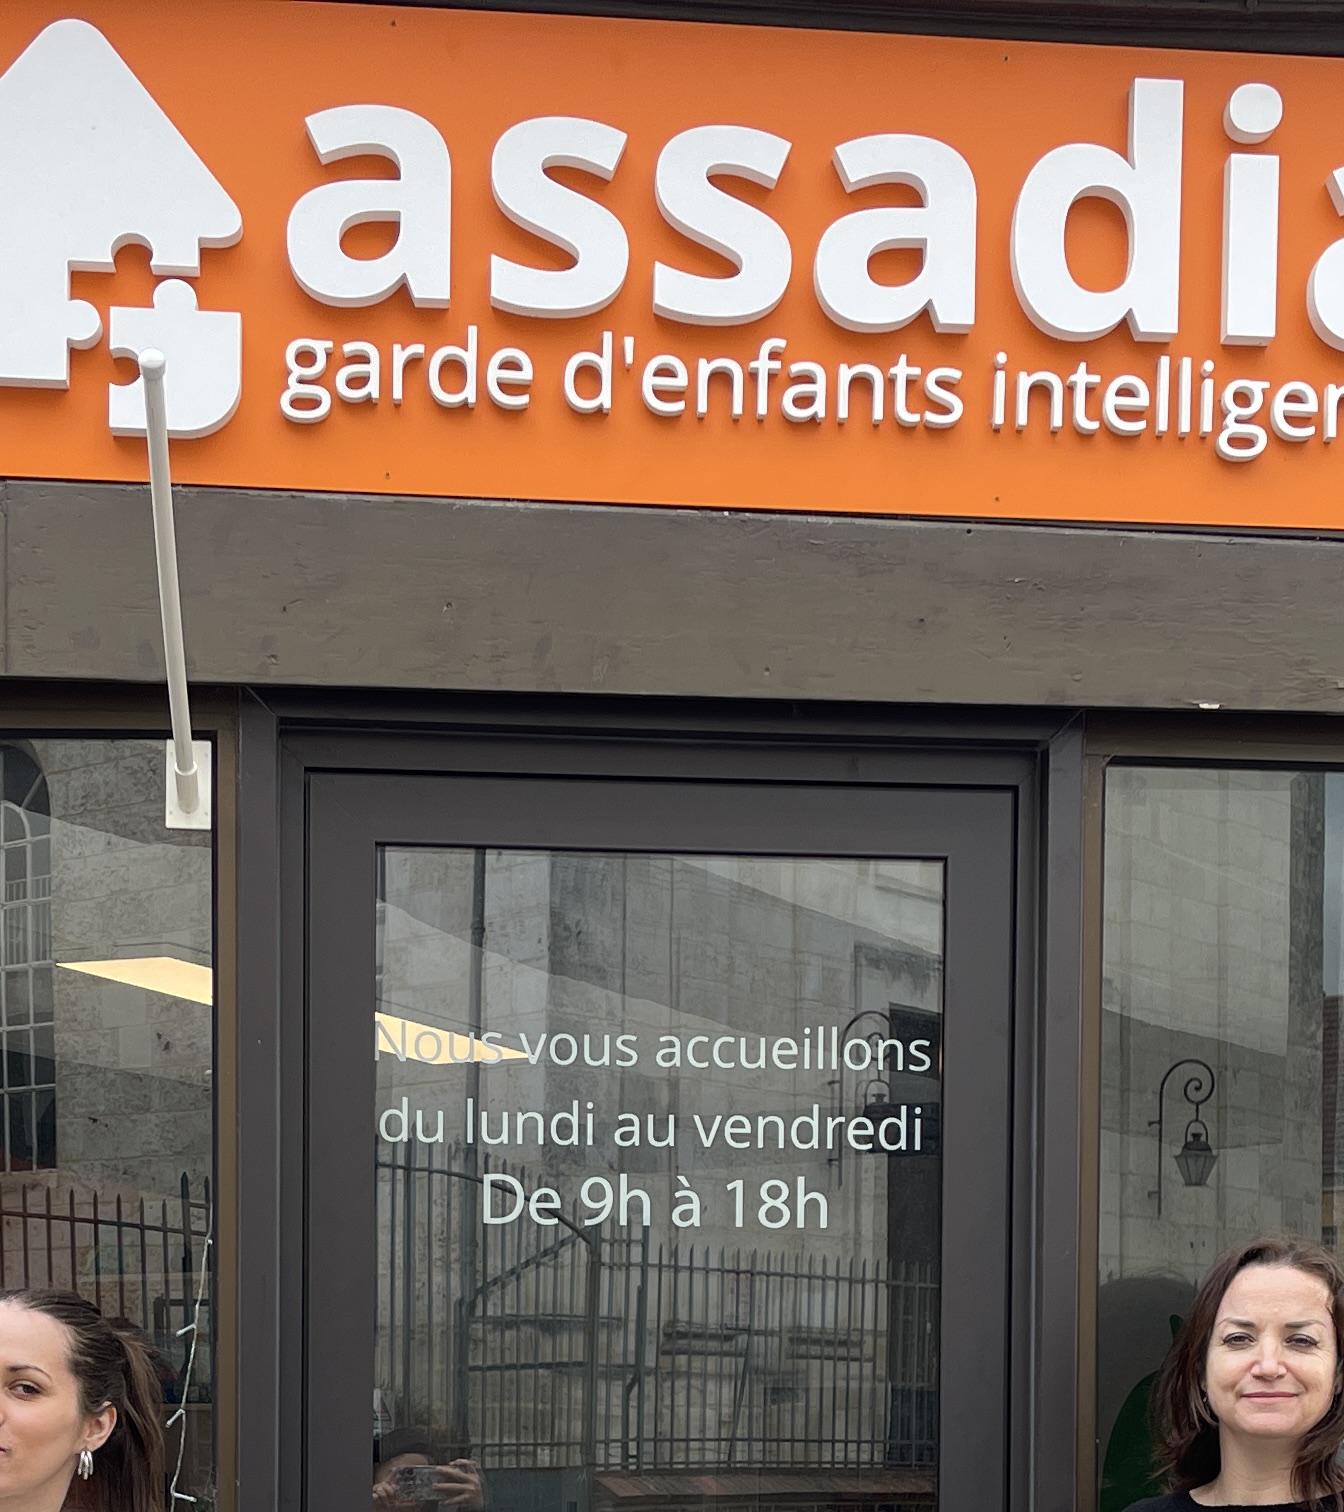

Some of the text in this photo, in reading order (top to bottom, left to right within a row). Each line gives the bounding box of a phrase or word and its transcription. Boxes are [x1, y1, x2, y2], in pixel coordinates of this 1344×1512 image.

[280, 326, 534, 423] garde
[563, 330, 964, 429] d'enfants
[374, 1020, 932, 1073] Nous vous accueillons
[378, 1097, 922, 1151] du lundi au vendredi
[482, 1173, 828, 1231] De 9h à 18h
